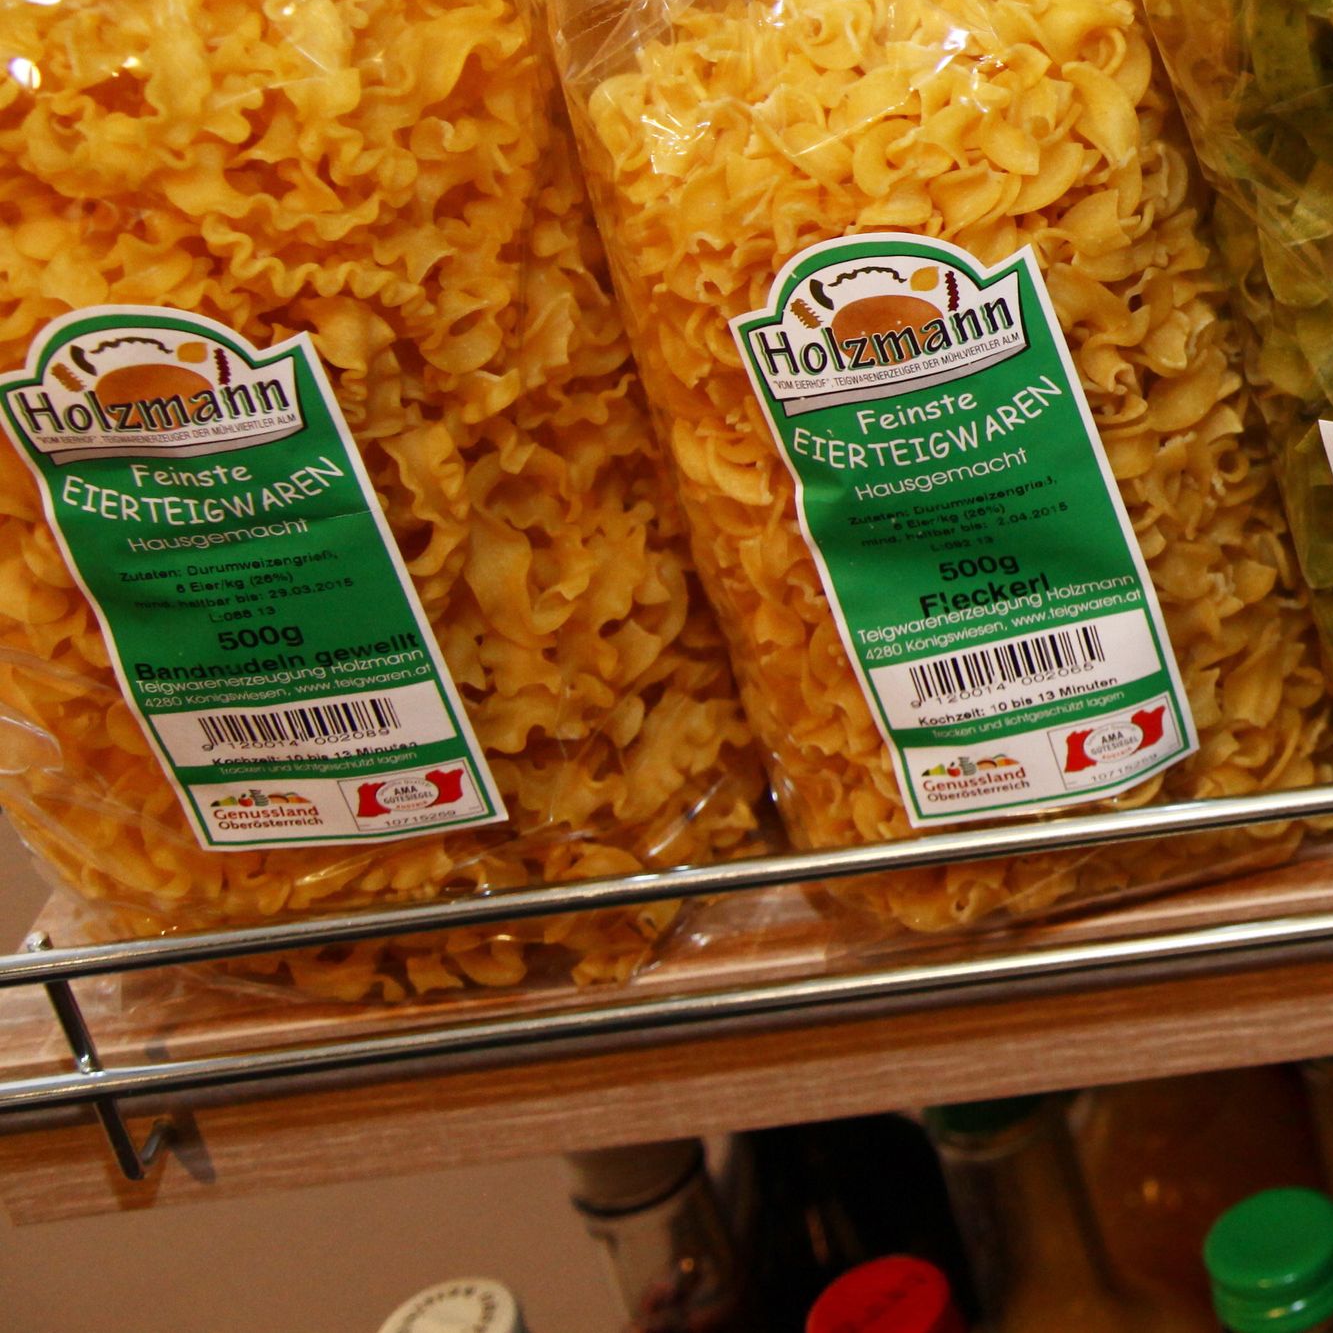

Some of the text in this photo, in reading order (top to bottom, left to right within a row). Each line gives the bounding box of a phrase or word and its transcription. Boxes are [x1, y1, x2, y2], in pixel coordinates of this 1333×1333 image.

[756, 297, 1014, 376] Holzmann
[834, 362, 922, 387] TEIGWARENERZEUGER
[922, 359, 940, 371] DER
[941, 341, 1001, 366] MÜHLVIERTLER
[1002, 332, 1021, 346] ALM
[15, 378, 290, 433] Holzmann
[277, 413, 296, 426] ALM
[793, 375, 1063, 469] EIERTEIGWAREN
[856, 393, 978, 435] Feinste
[62, 456, 344, 526] EIERTEIGWAREN
[130, 463, 253, 488] Feinste
[854, 448, 1028, 501] Hausgemacht
[127, 518, 309, 553] Hausgemacht
[938, 554, 1021, 583] 500g
[857, 574, 1135, 644] Teigwarenerzeugung Holzmann
[865, 589, 1142, 660] 4280 Königswiesen, www.teigwaren.at
[134, 632, 419, 681] Bandnudeln gewellt
[217, 624, 305, 652] 500g
[136, 649, 424, 695] Teigwarenerzeugung Holzmann
[143, 663, 431, 709] 4280 www.teigwaren.at
[918, 676, 1118, 728] Kochzeit: 10 bis 13 Minuten
[979, 720, 1002, 733] und
[1086, 691, 1125, 708] lagern
[227, 728, 391, 751] 120014 002089
[1101, 731, 1124, 745] AMA
[393, 785, 418, 795] AMA
[922, 768, 1026, 792] Genussland
[927, 780, 1030, 803] Oberösterreich
[213, 805, 319, 820] Genussland
[218, 817, 323, 831] Oberösterreich
